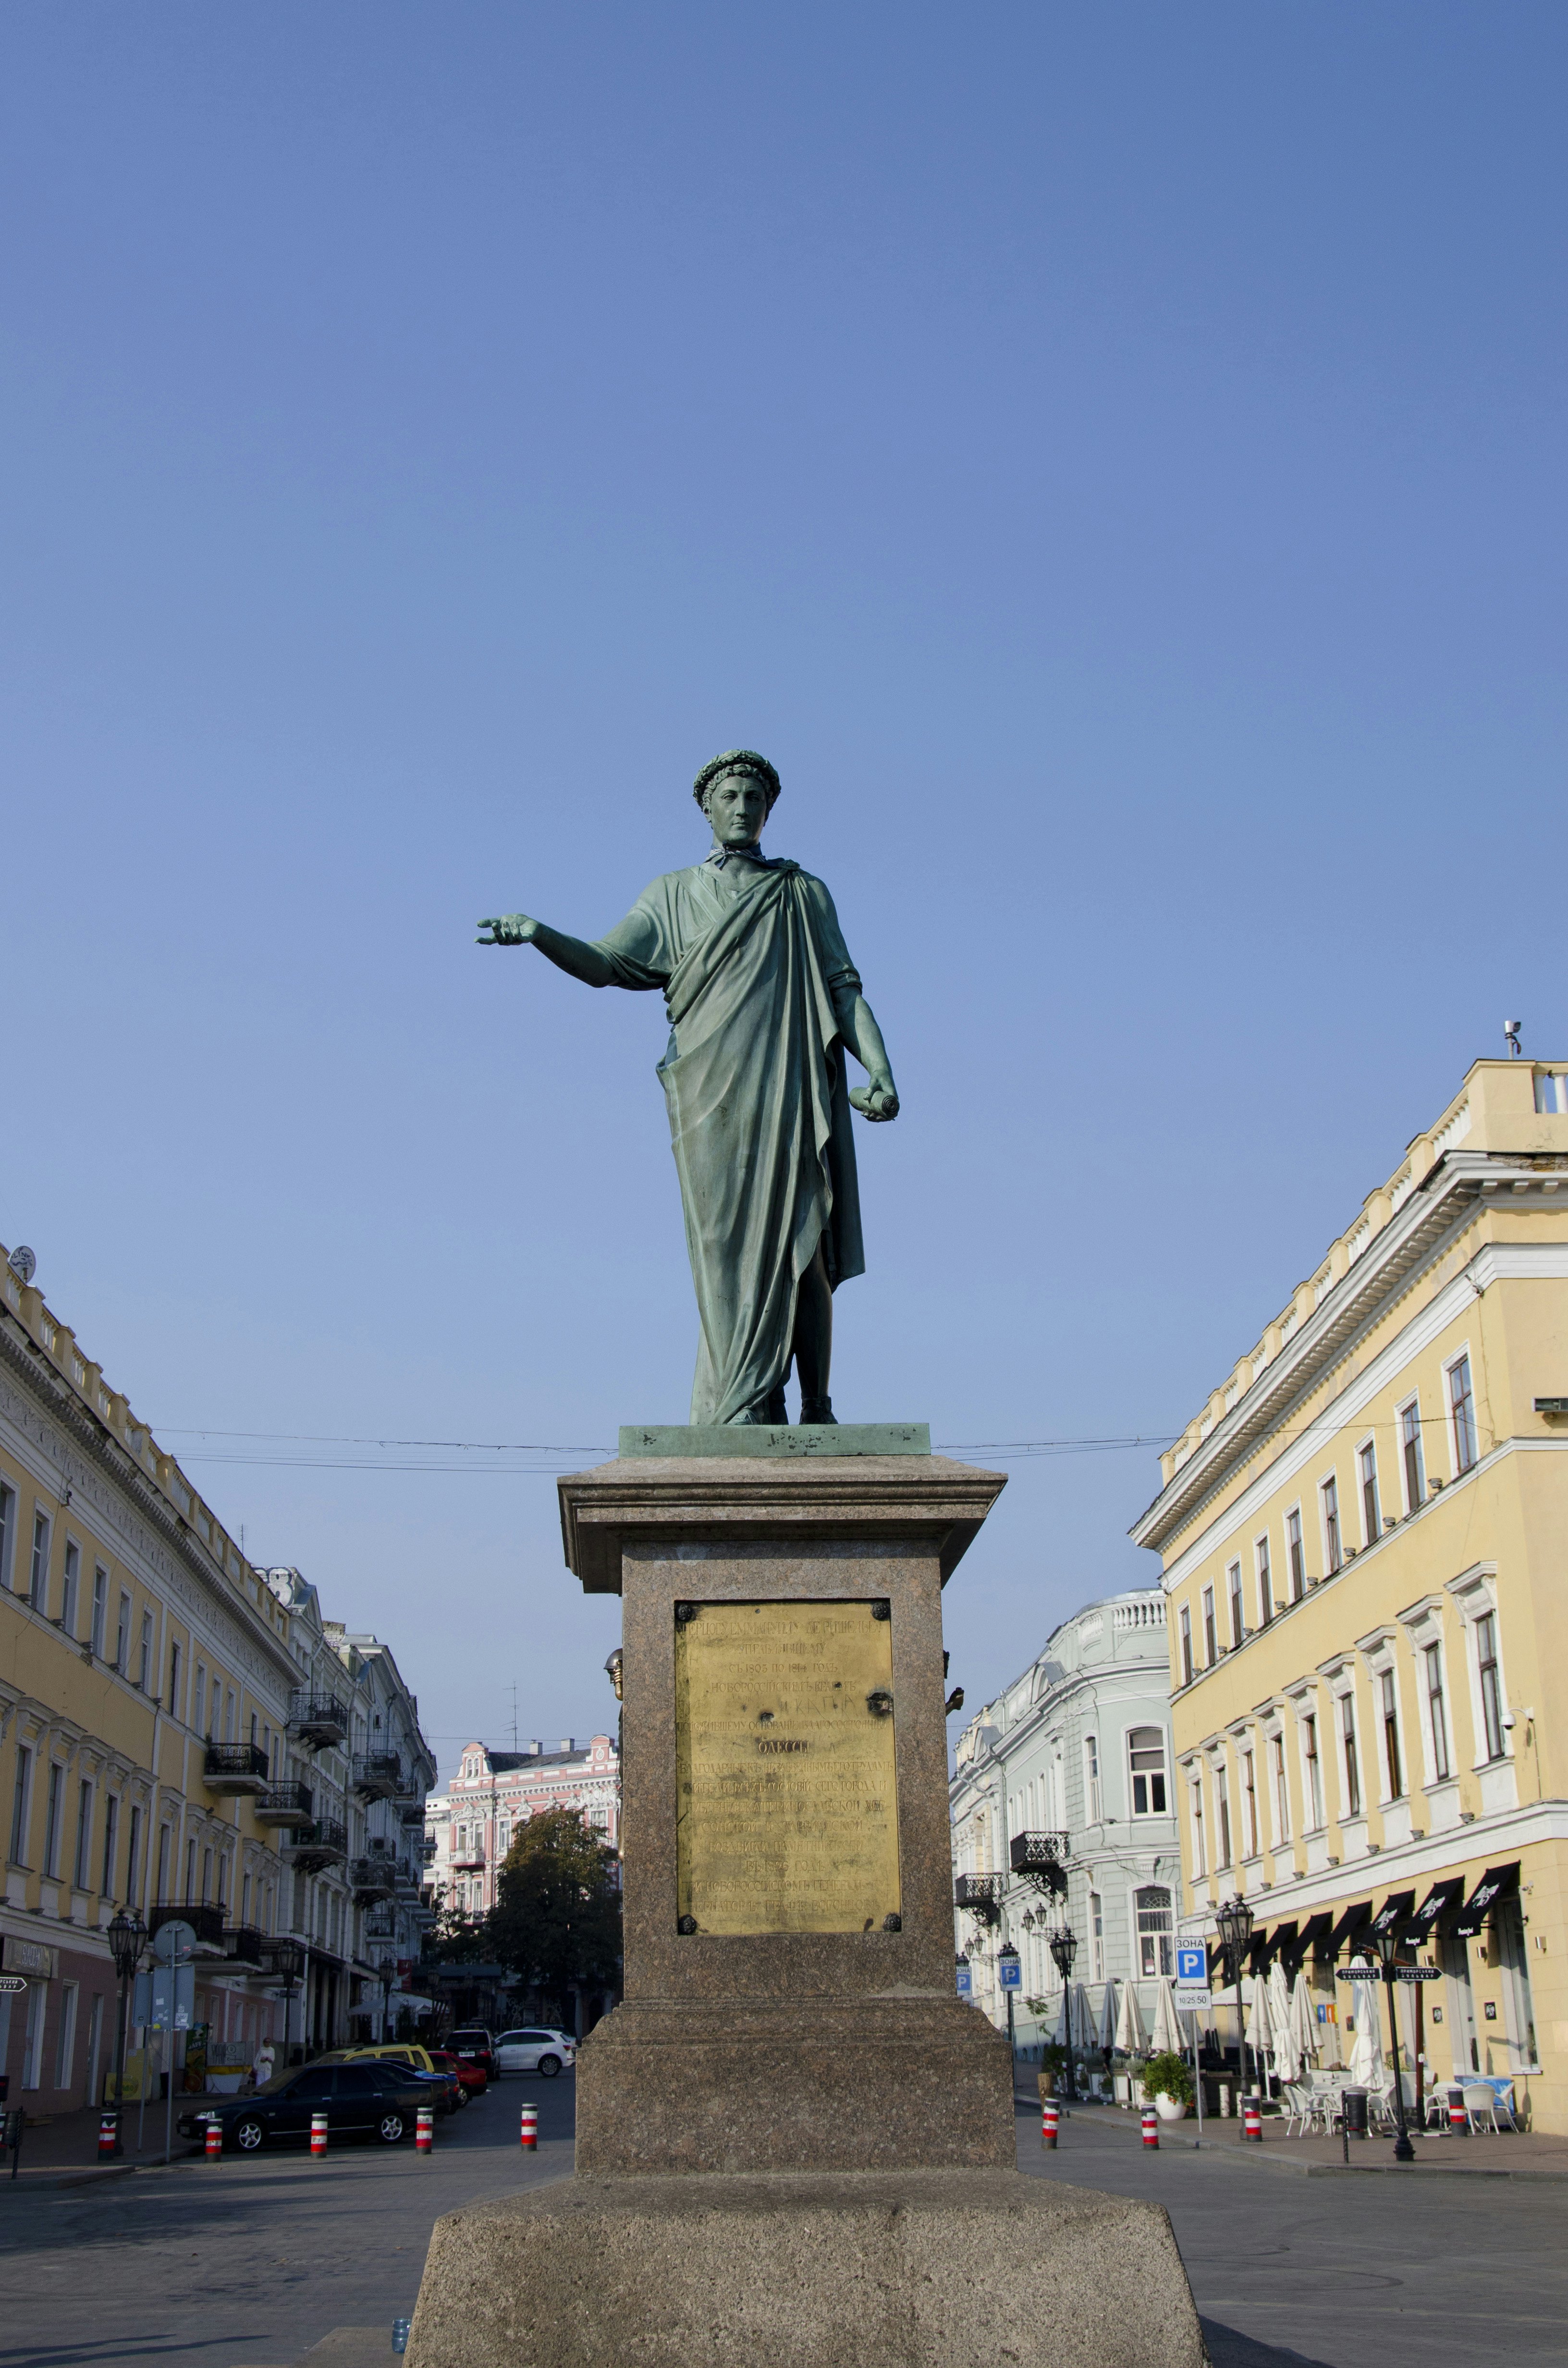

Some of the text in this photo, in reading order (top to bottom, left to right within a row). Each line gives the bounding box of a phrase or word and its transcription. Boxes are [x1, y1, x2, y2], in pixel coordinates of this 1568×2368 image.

[745, 1664, 768, 1673] 1803
[772, 1664, 784, 1673] ПО
[758, 1740, 809, 1754] ОДЕССЫ
[880, 1780, 887, 1791] И
[1176, 1939, 1204, 1948] ЗОНА
[1184, 1954, 1199, 1974] P
[1197, 1996, 1207, 2004] 50
